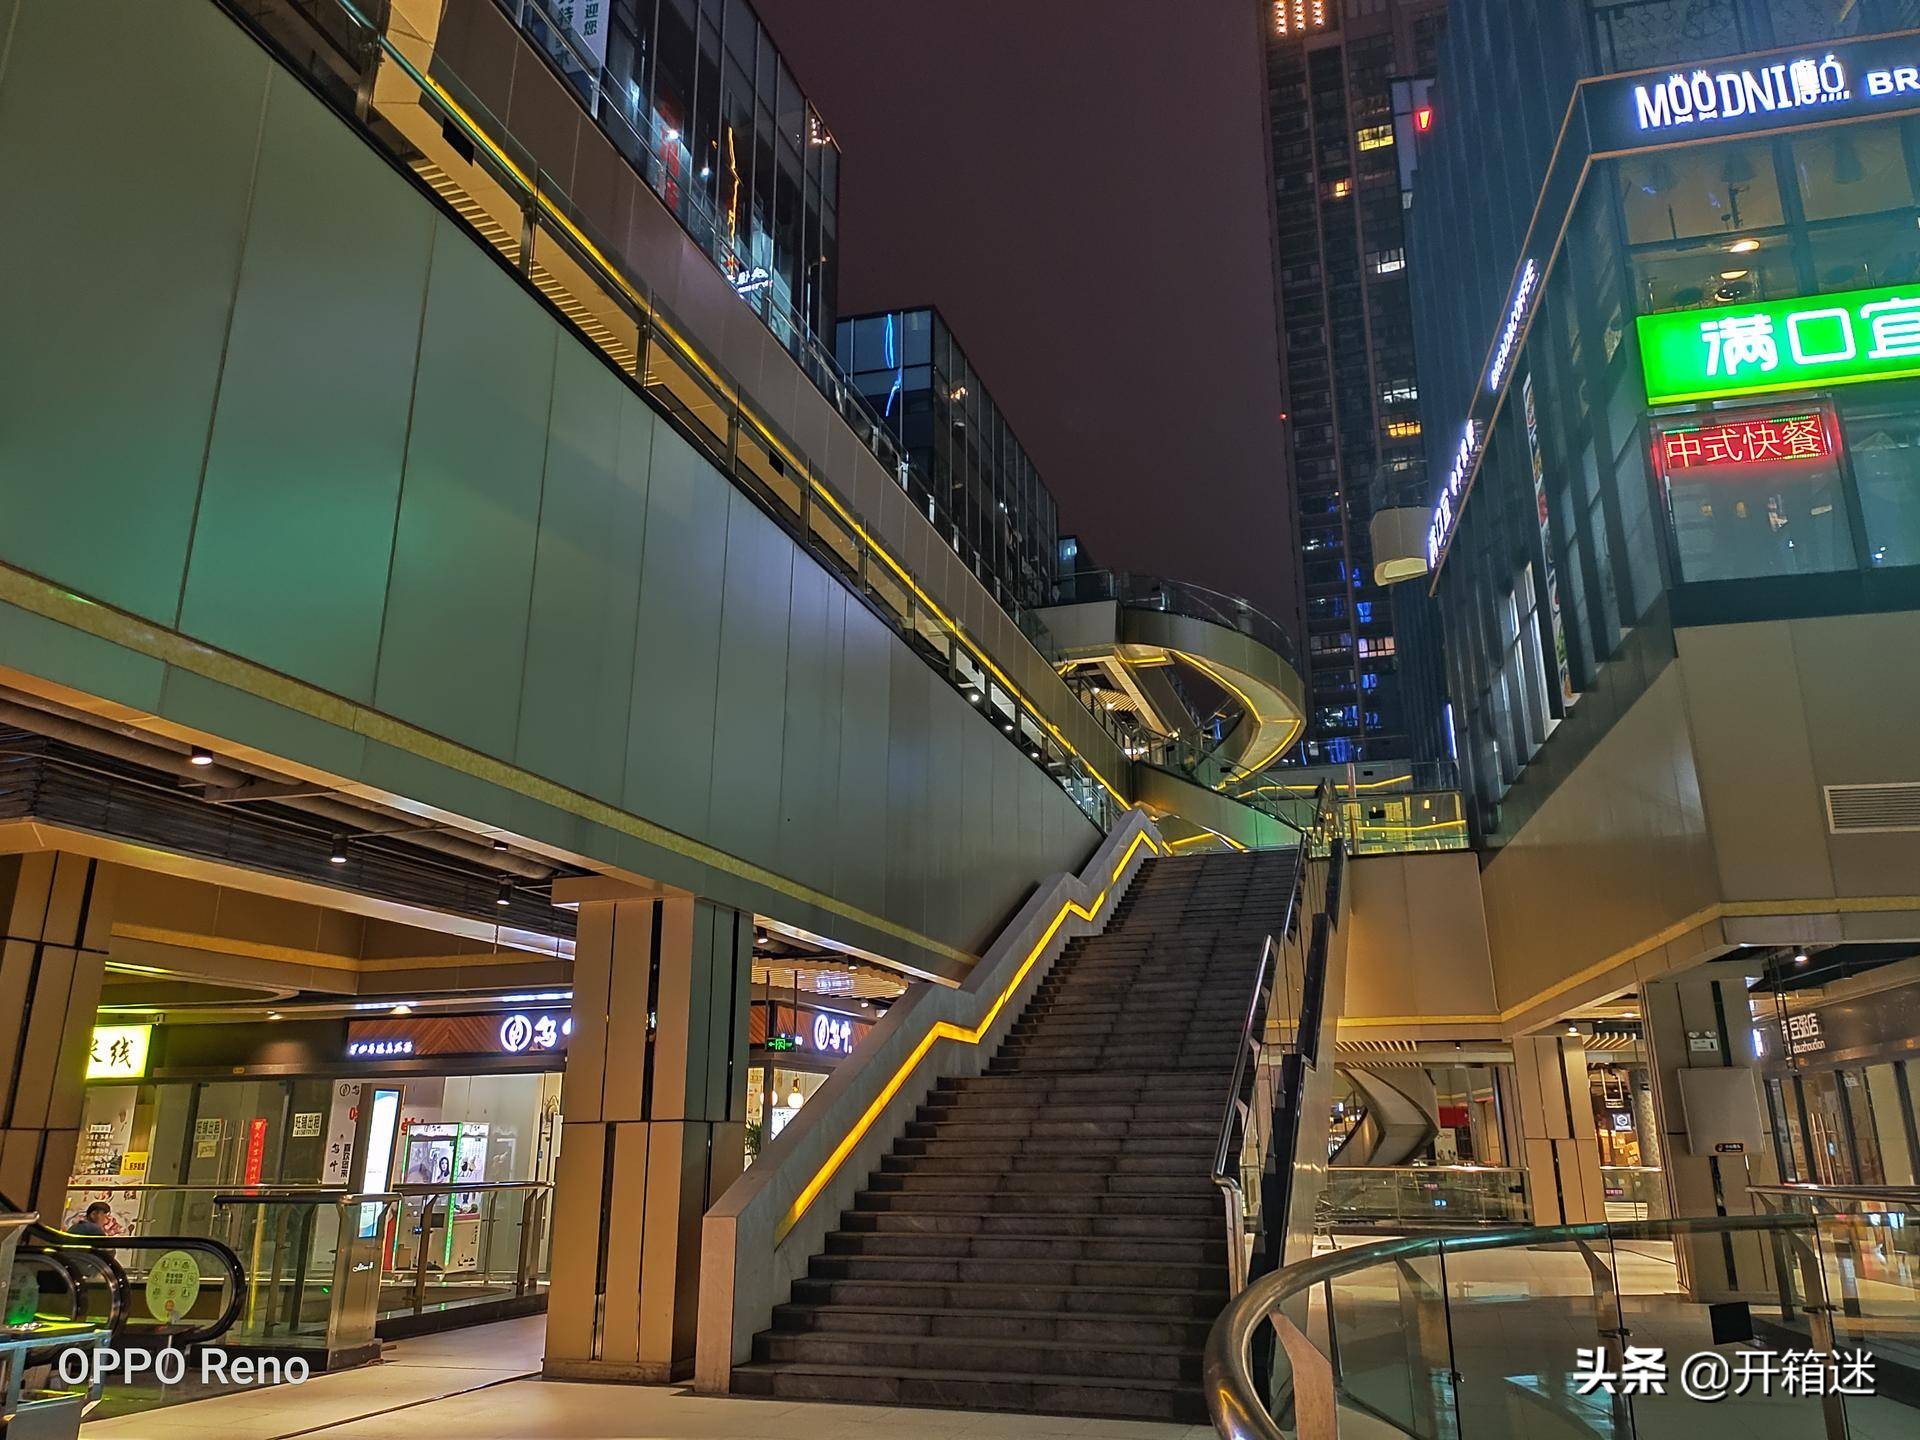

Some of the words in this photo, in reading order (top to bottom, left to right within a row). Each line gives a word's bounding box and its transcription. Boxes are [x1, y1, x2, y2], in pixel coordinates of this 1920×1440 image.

[584, 0, 599, 36] 迎您
[1669, 419, 1822, 467] 中式快餐
